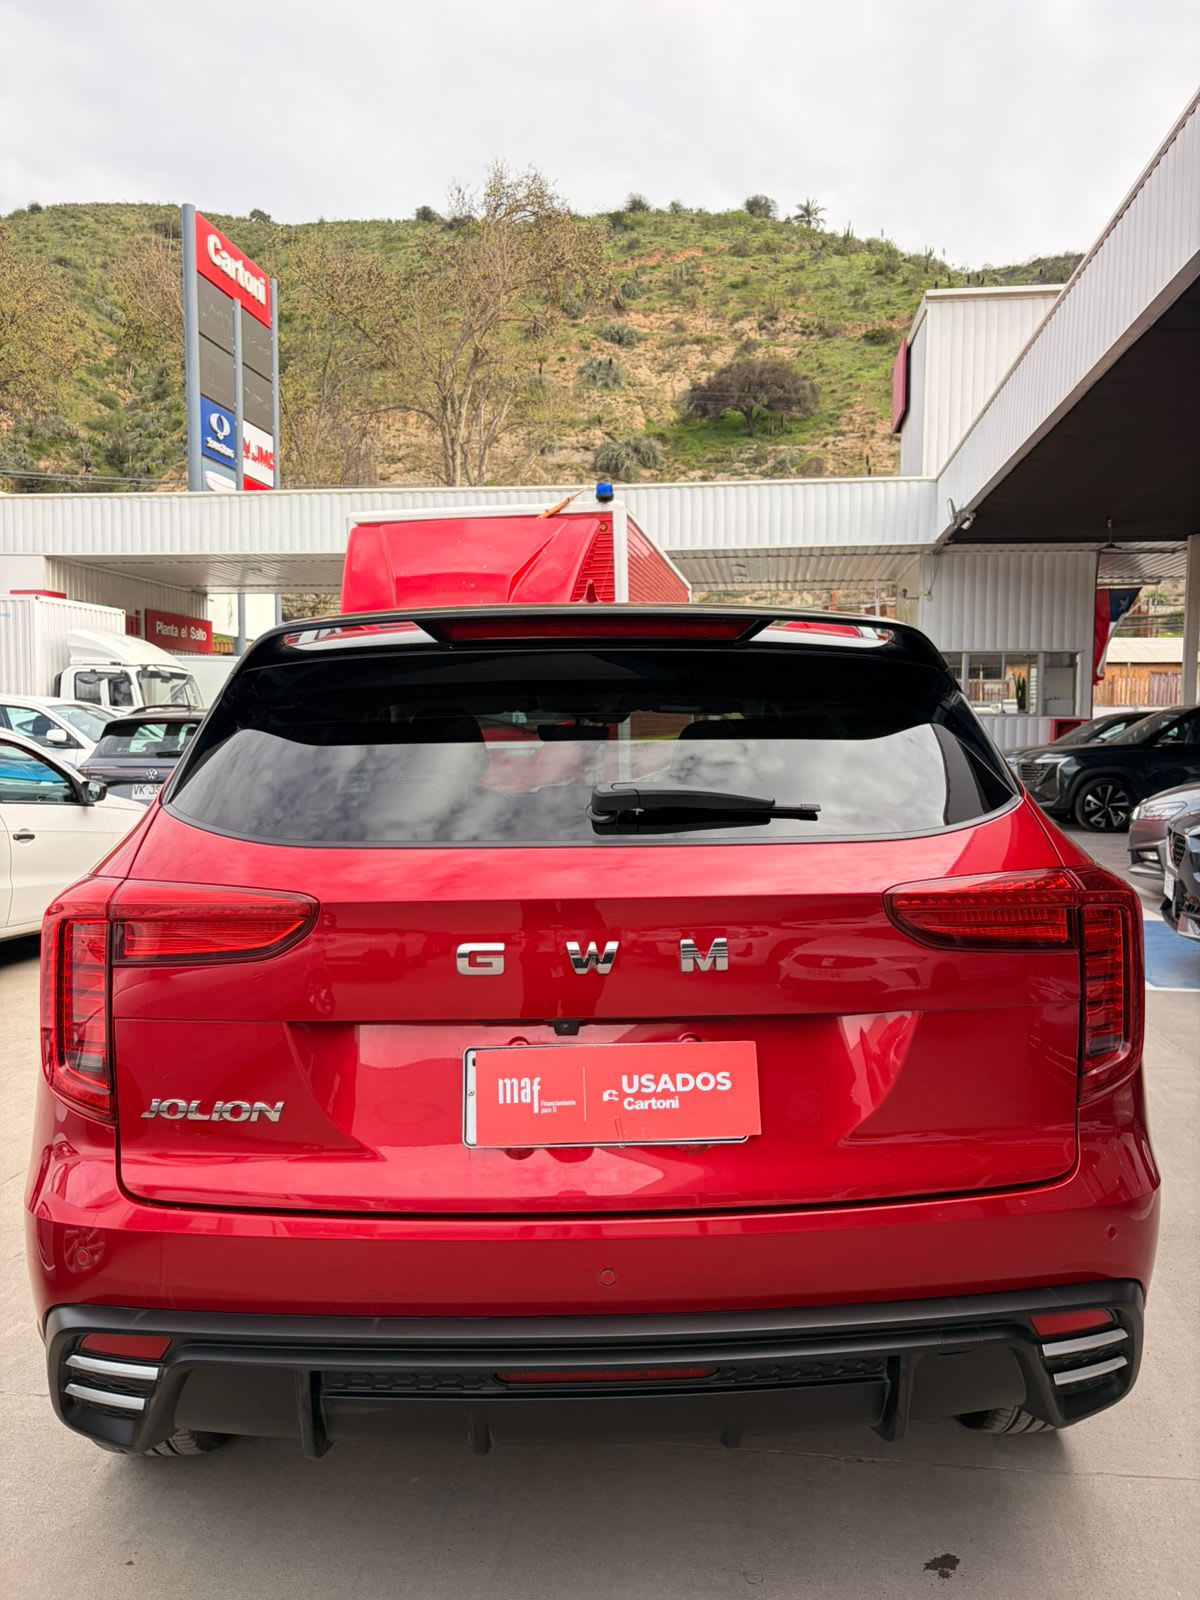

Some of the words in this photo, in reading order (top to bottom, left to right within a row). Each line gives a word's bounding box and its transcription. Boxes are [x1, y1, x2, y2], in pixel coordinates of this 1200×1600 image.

[207, 233, 267, 306] Cartoni
[156, 620, 179, 637] Planta
[181, 624, 188, 638] el
[190, 626, 207, 641] Salto
[621, 1071, 732, 1094] USADOS
[498, 1077, 541, 1114] maf
[623, 1096, 680, 1111] Cartoni
[140, 1098, 285, 1123] JOLION
